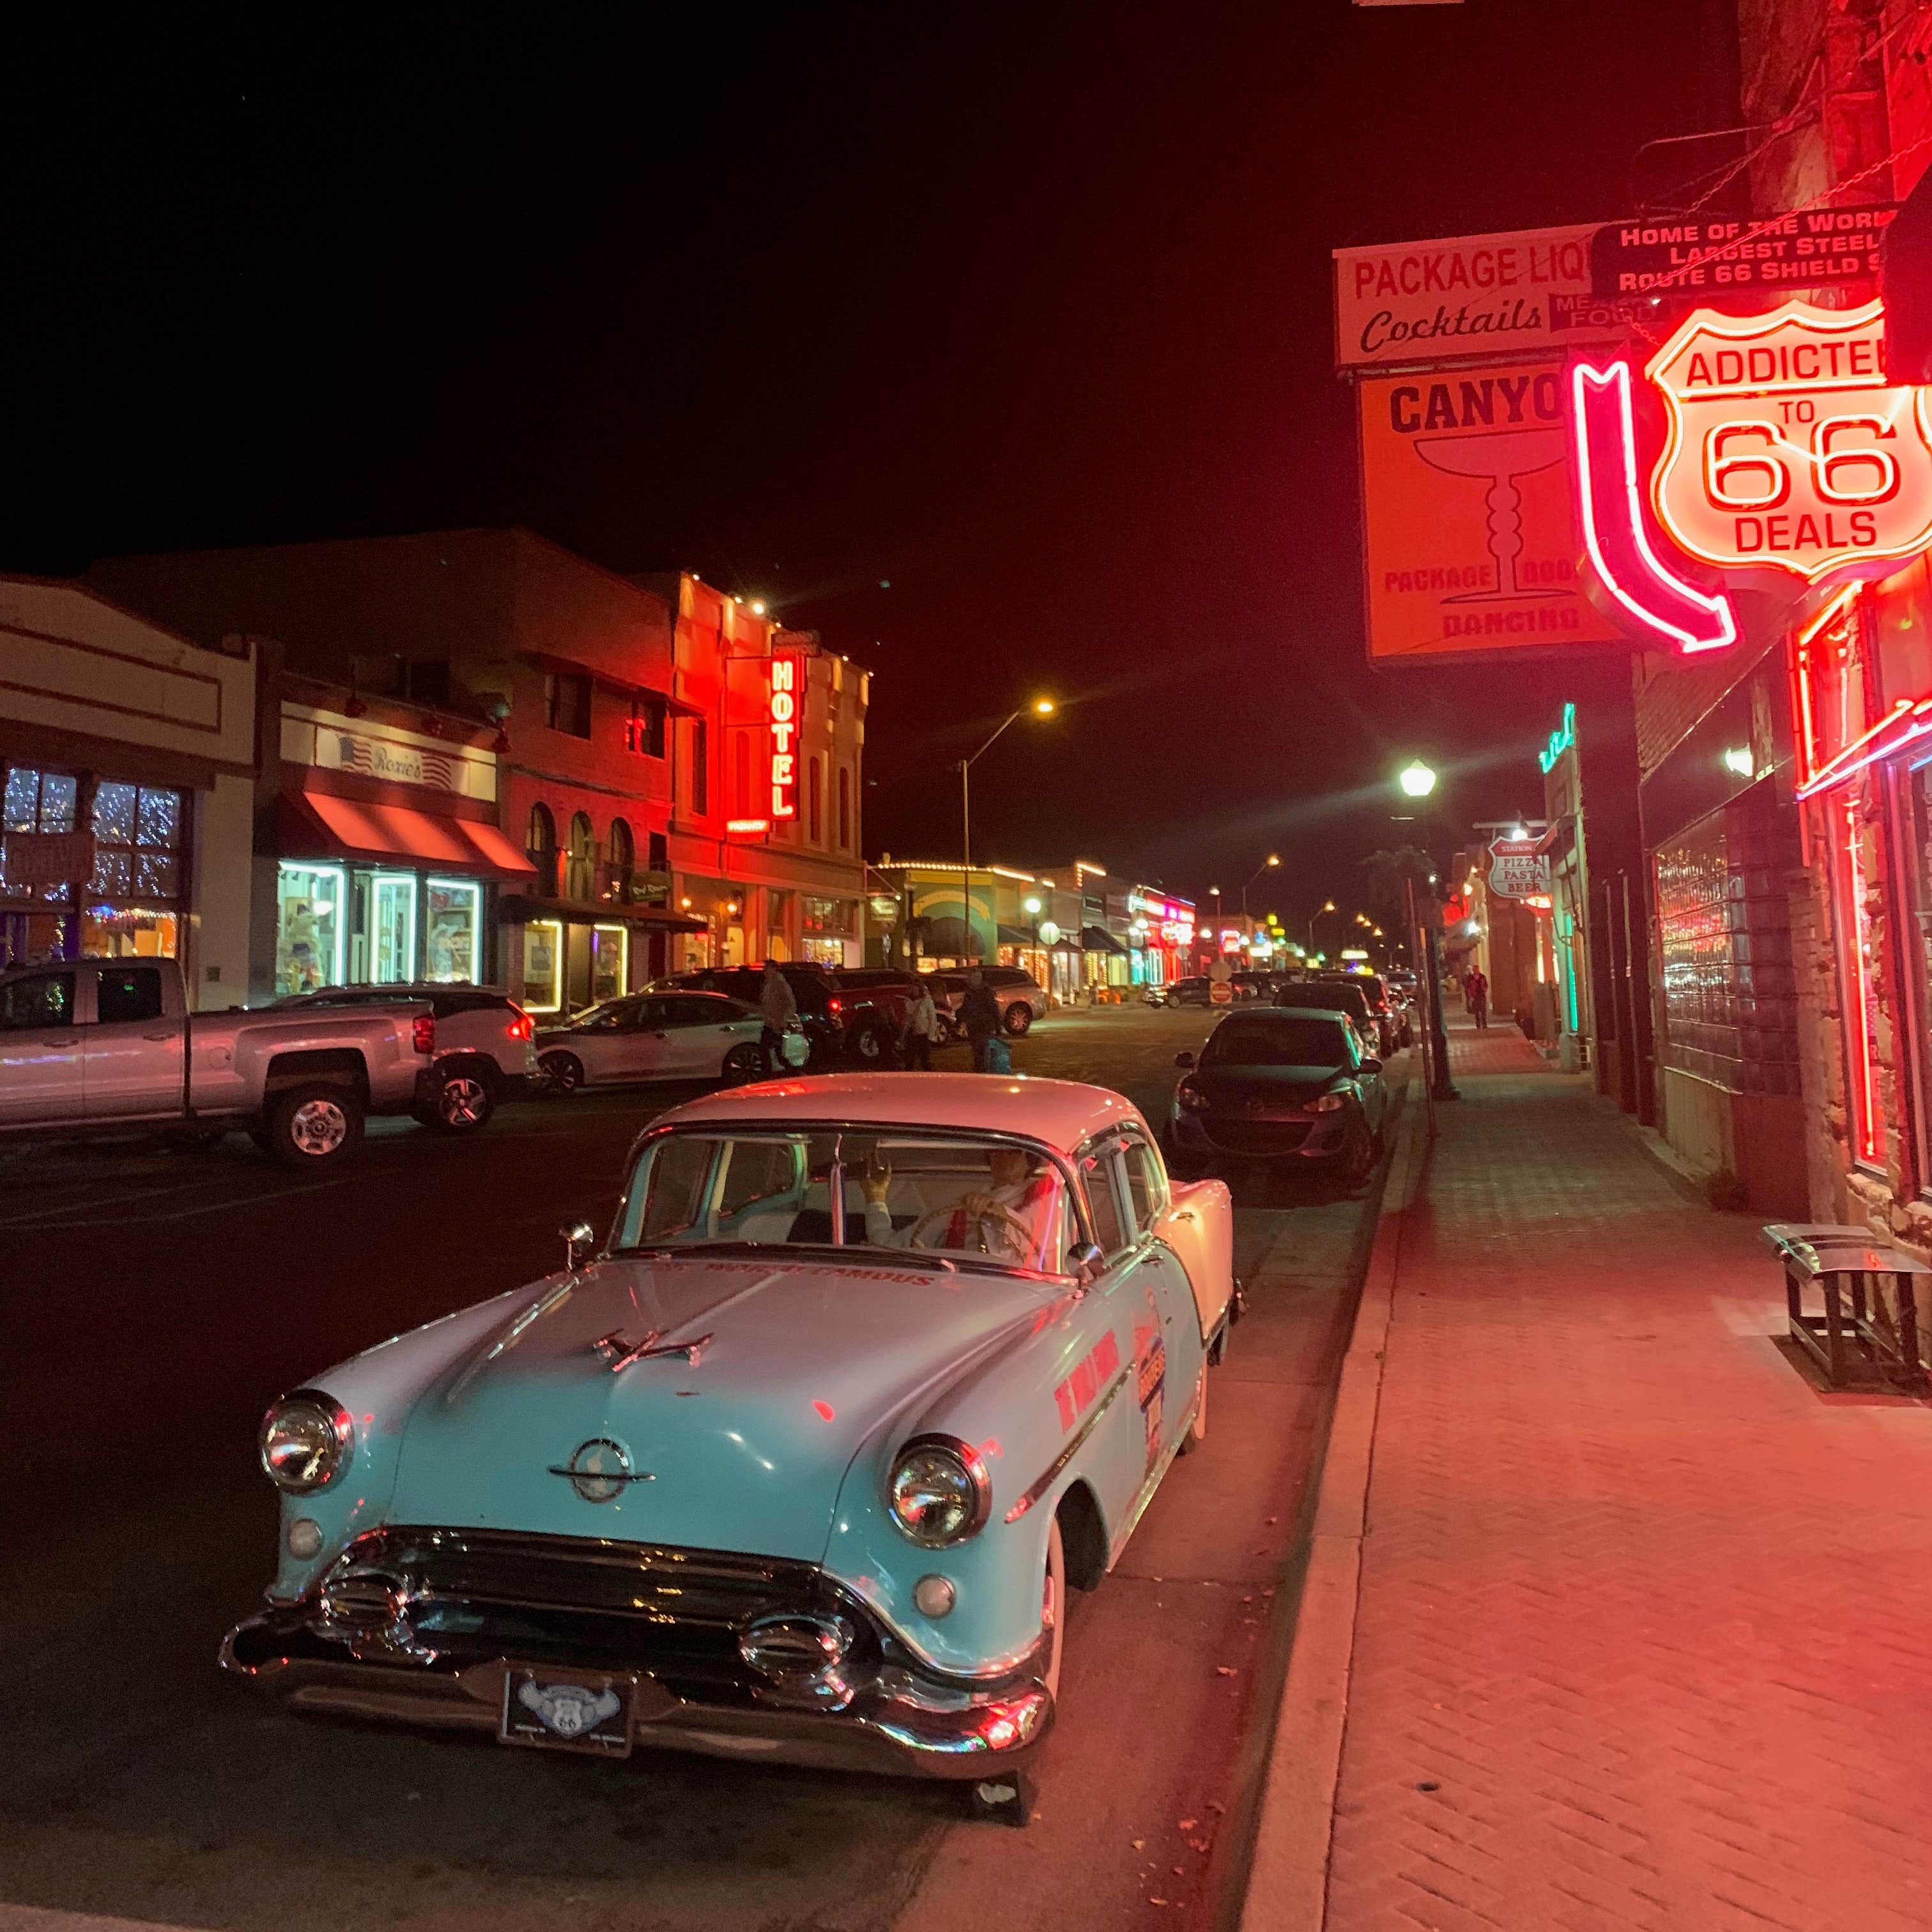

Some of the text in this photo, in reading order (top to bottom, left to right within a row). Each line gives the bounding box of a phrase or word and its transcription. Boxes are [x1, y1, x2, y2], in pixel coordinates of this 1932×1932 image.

[1621, 226, 1699, 247] HOME
[1708, 223, 1740, 240] OF
[1749, 217, 1798, 236] THE
[1670, 234, 1880, 264] LARGEST STEEL
[1354, 241, 1592, 299] PACKAGE LIQ
[1619, 268, 1705, 291] ROUTE
[1715, 264, 1752, 283] 66
[1761, 257, 1859, 280] SHIELD
[1360, 298, 1542, 353] Cocktails
[1685, 339, 1885, 387] ADDICTE
[1390, 373, 1565, 433] CANYO
[1779, 400, 1814, 424] TO
[1702, 413, 1901, 512] 66
[1735, 511, 1877, 553] DEALS
[1384, 564, 1494, 593] PACKAGE
[1442, 608, 1579, 638] DANCING
[770, 661, 794, 816] HOTEL
[1503, 858, 1544, 868] PIZZA
[1504, 870, 1544, 880] PASTA
[1508, 883, 1542, 893] BEER
